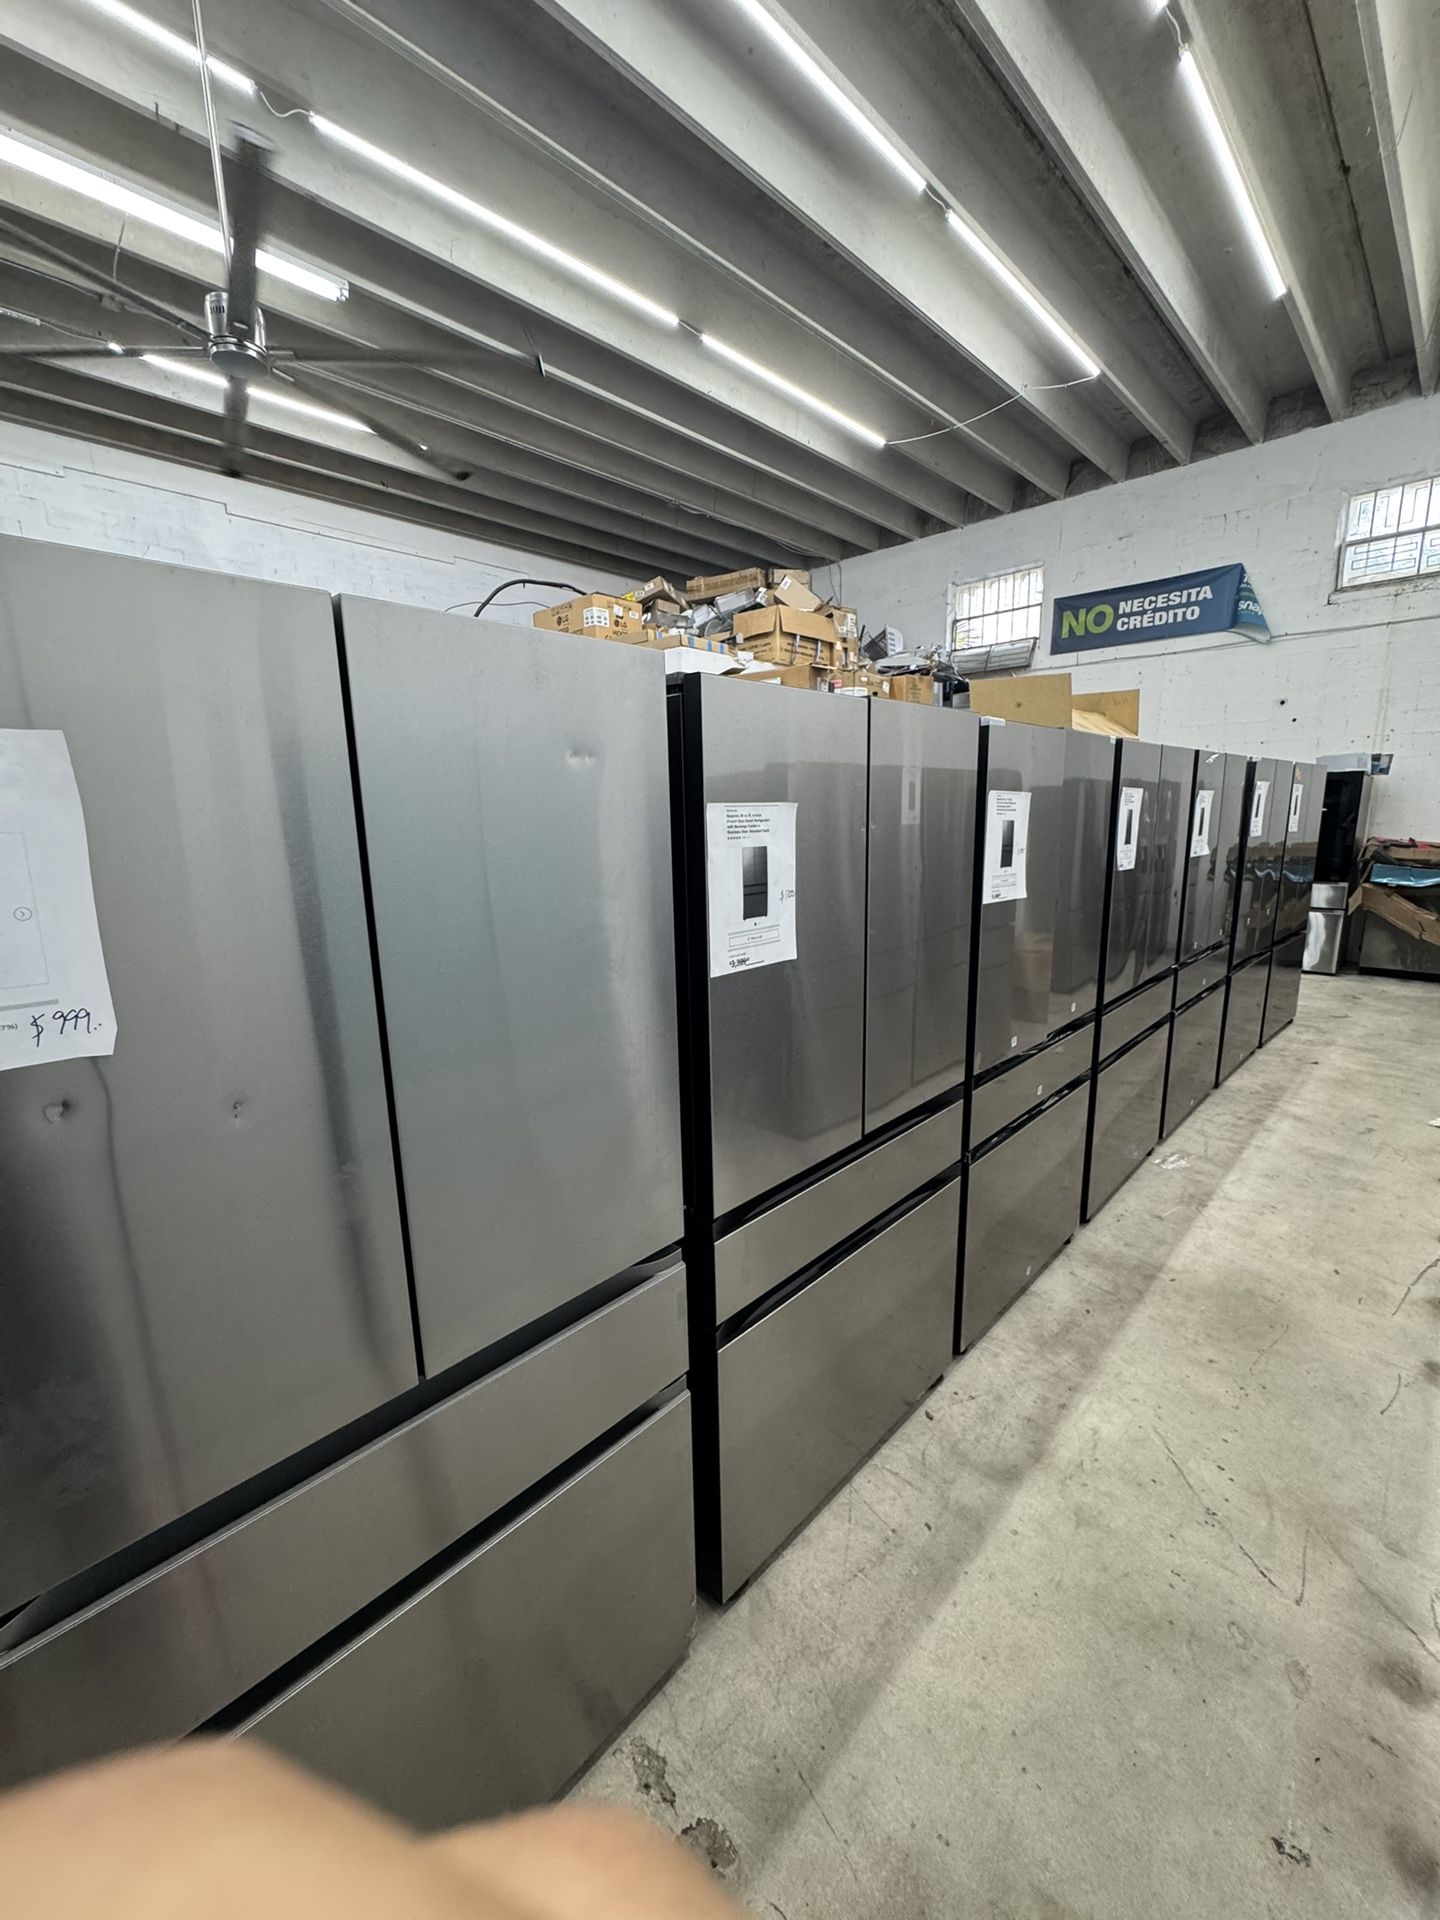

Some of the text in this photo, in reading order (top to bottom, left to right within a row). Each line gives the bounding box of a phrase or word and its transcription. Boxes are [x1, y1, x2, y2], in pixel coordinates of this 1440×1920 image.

[1061, 585, 1213, 639] NO NECESITA
[1116, 605, 1201, 632] CRÉDITO
